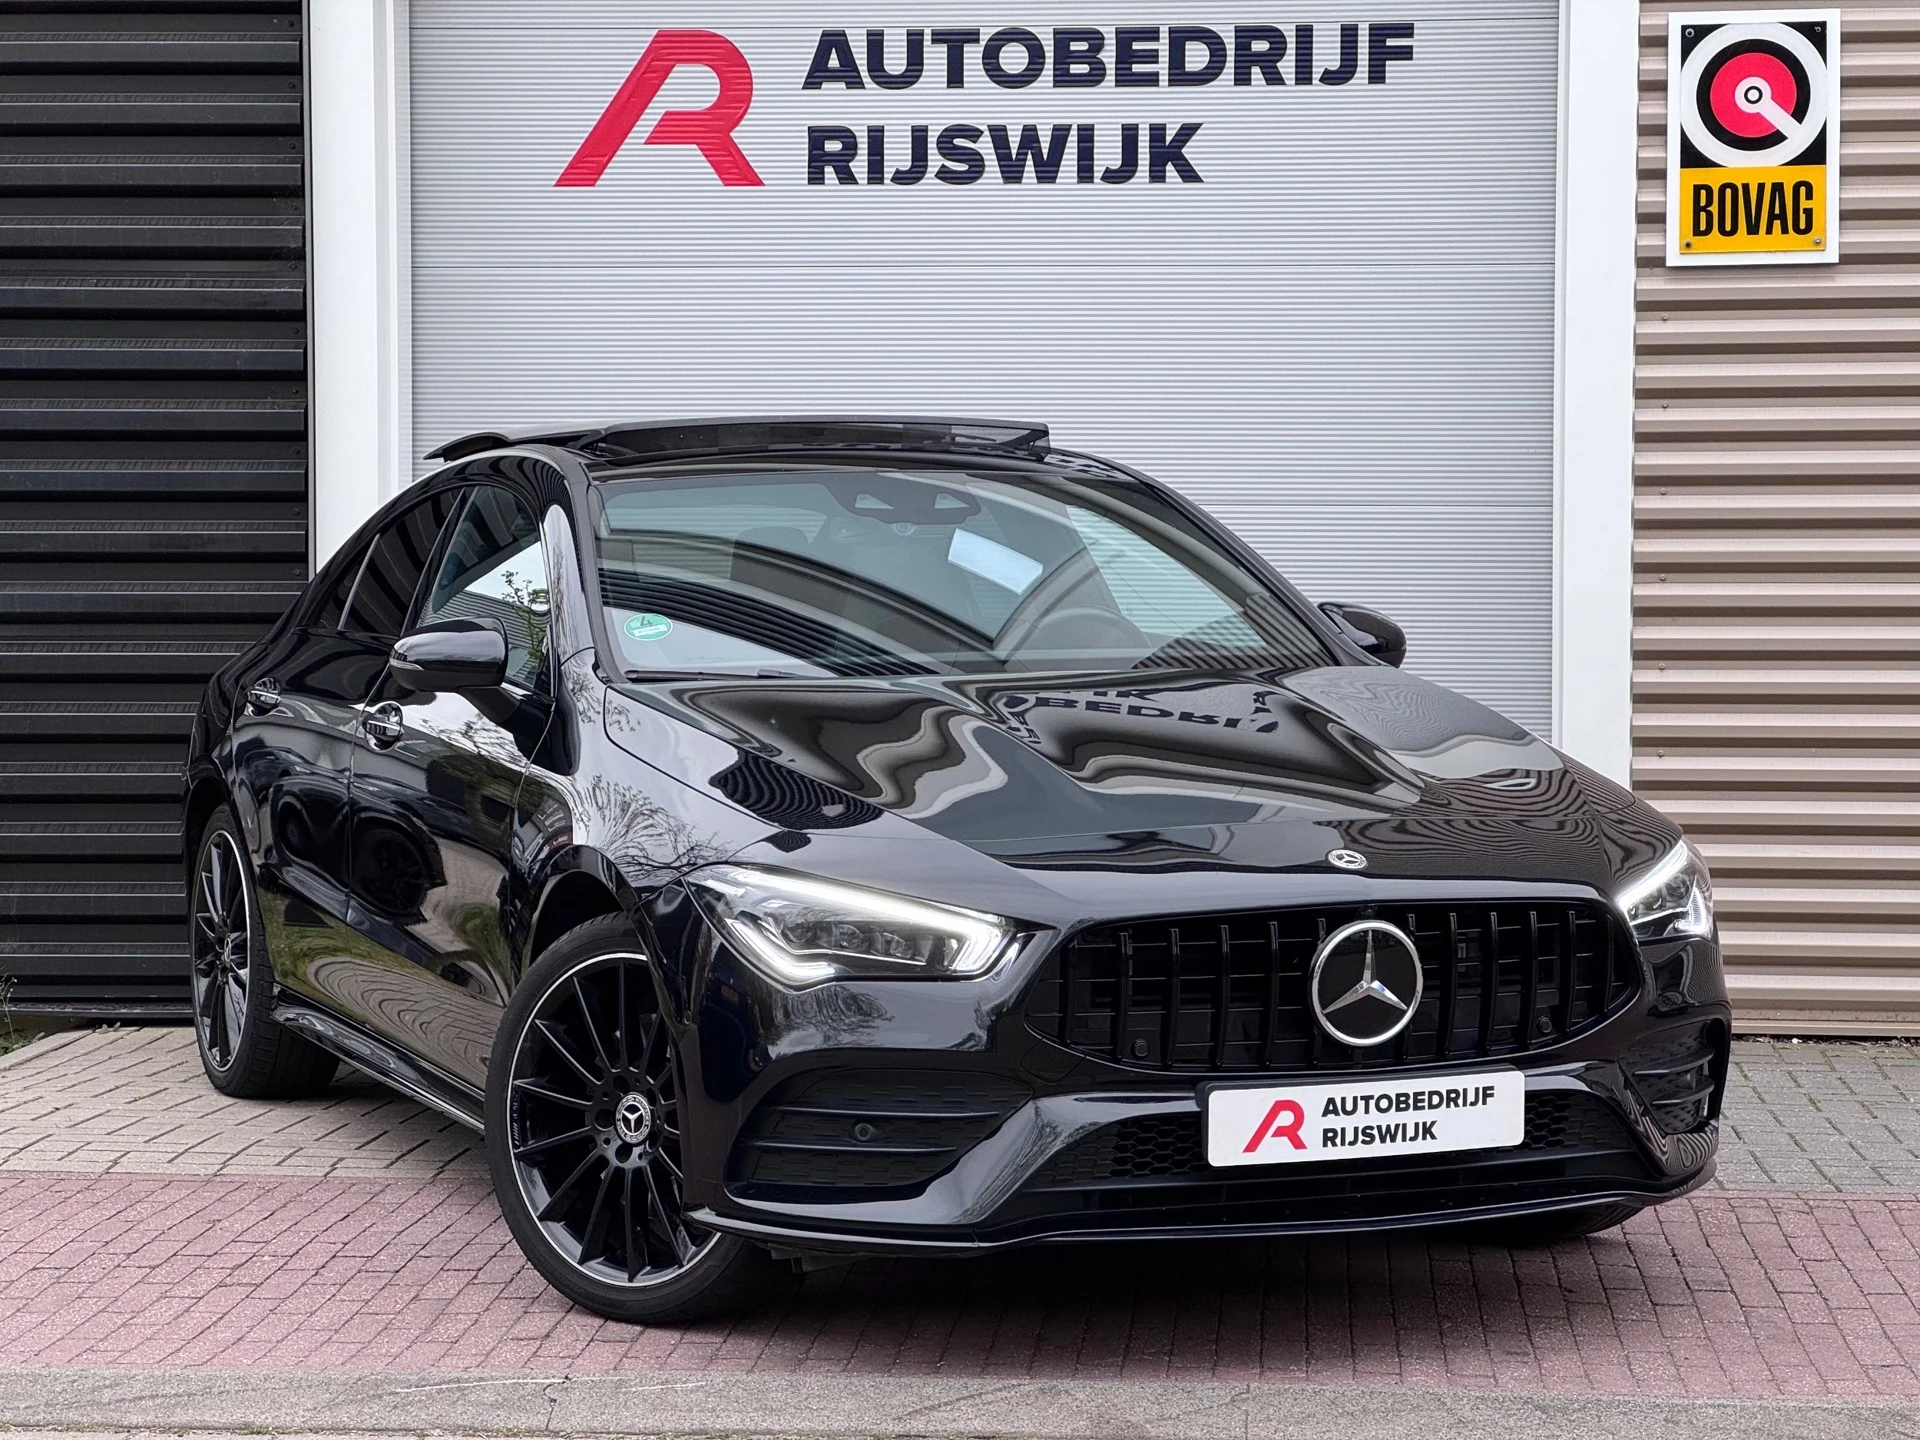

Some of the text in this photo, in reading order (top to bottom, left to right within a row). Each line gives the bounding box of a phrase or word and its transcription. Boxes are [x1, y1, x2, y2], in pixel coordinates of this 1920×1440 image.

[801, 23, 1415, 91] AUTOBEDRIJF
[808, 123, 1205, 187] RIJSWIJK
[1692, 180, 1814, 238] BOVAG
[1321, 1085, 1496, 1118] AUTOBEDRIJF
[1322, 1120, 1438, 1148] RIJSWIJK
